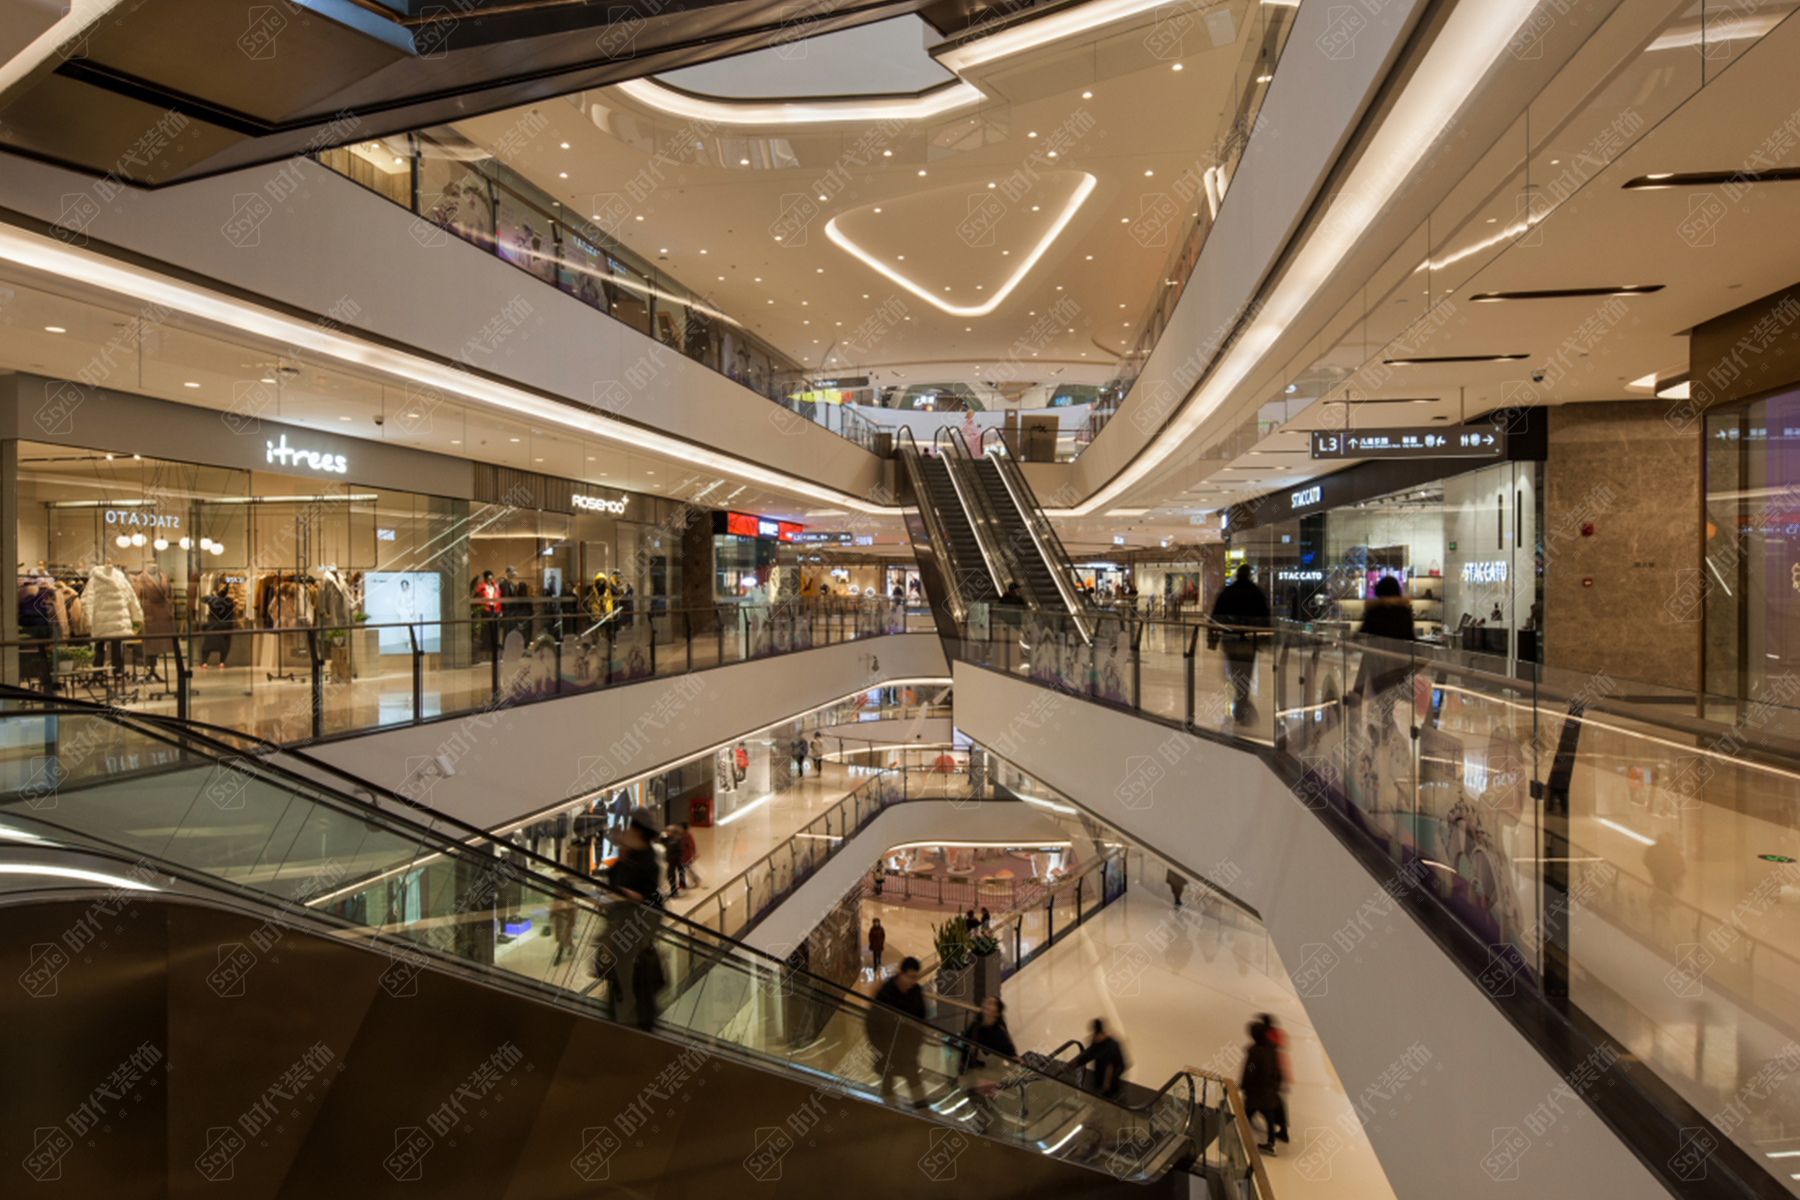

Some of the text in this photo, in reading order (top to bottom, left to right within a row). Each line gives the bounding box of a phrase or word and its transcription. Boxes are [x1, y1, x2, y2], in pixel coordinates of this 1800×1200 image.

[1319, 437, 1338, 452] L3
[266, 434, 346, 474] itrees
[1278, 572, 1322, 581] STACCATO
